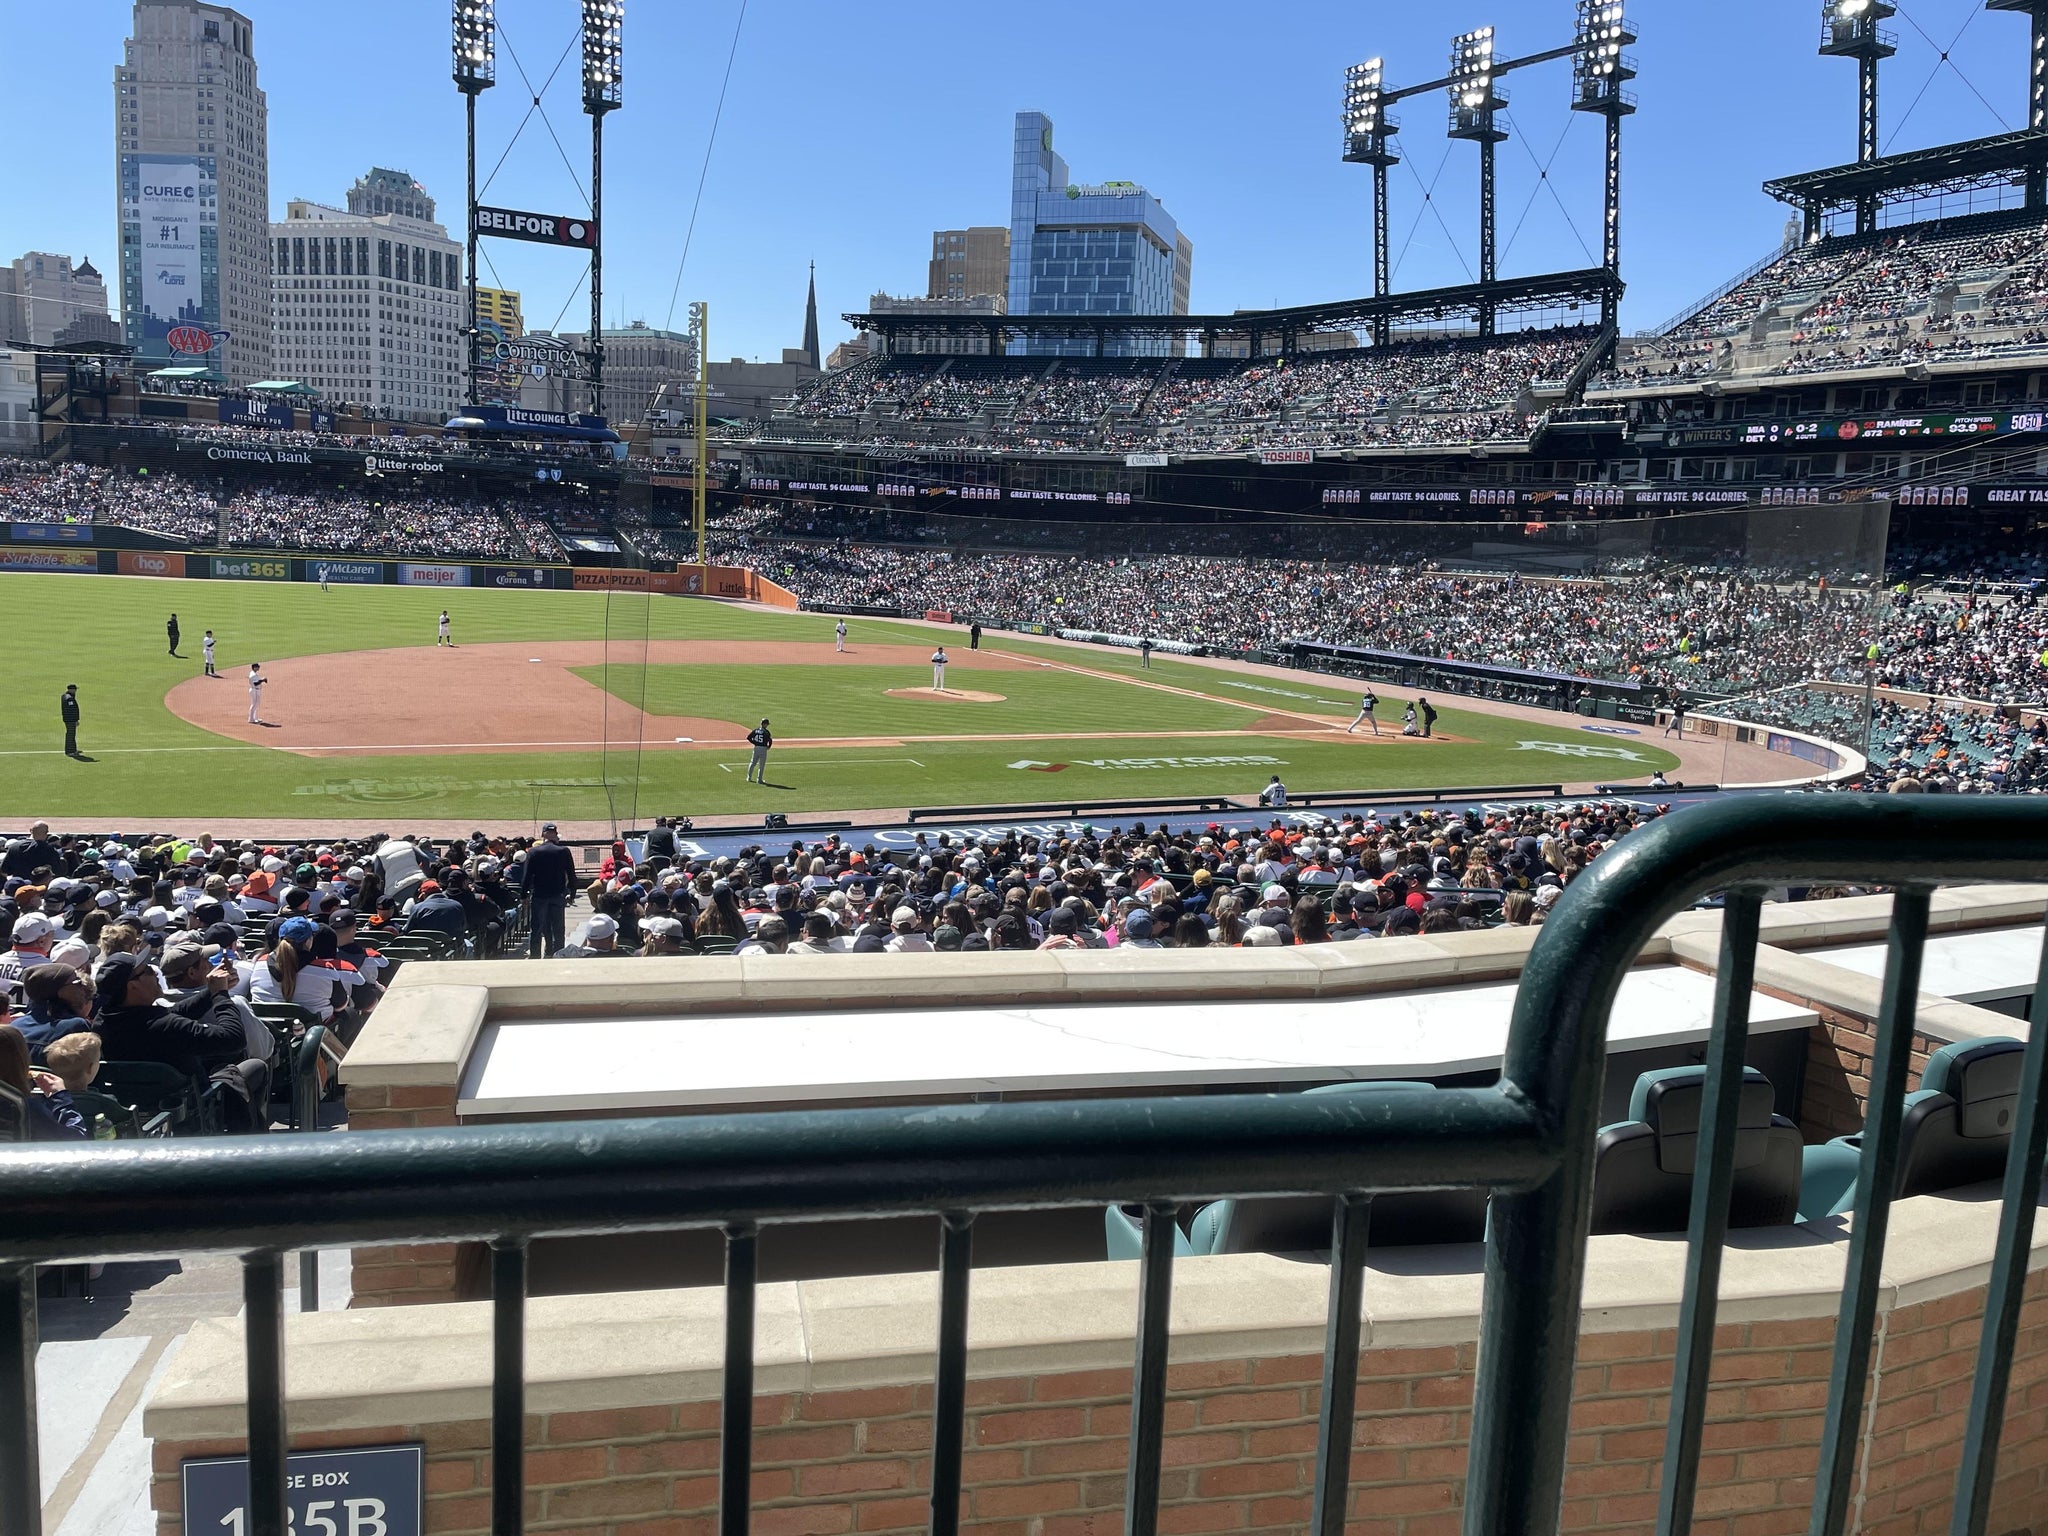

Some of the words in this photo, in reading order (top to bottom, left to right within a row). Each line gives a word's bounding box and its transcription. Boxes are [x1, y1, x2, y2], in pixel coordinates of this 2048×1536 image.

[144, 186, 182, 197] CURE
[1080, 184, 1141, 199] Huntington
[478, 210, 555, 236] BELFOR
[160, 225, 180, 241] #1
[171, 327, 210, 354] AAA
[232, 413, 267, 424] PITCHER'S
[269, 417, 282, 425] PUB
[529, 412, 566, 424] LOUNGE
[1747, 426, 1766, 434] MIA
[1948, 424, 1978, 432] 93.9
[1978, 424, 1996, 432] MPH
[1684, 429, 1732, 443] WINTER'S
[1746, 434, 1766, 442] DET
[277, 451, 312, 464] Bank
[1264, 450, 1311, 463] TOSHIBA
[788, 482, 808, 490] GREAT
[839, 484, 870, 492] CALORIES.
[1054, 492, 1064, 500] 96
[1064, 493, 1098, 501] CALORIES.
[1370, 492, 1391, 500] GREAT
[1415, 492, 1424, 500] 96
[1426, 492, 1461, 501] CALORIES.
[1636, 492, 1662, 502] GREAT
[1692, 492, 1704, 502] 96
[1705, 491, 1748, 502] CALORIES.
[1988, 490, 2026, 502] GREAT
[3, 552, 58, 566] Surfside
[216, 560, 286, 578] bet365
[332, 564, 375, 574] McLaren
[413, 567, 456, 584] meijer
[496, 576, 528, 586] Corona
[574, 574, 609, 586] PIZZA!
[612, 575, 646, 586] PIZZA!
[719, 582, 743, 594] Little
[1022, 624, 1043, 634] bet365
[1070, 755, 1280, 766] VICTORS
[1275, 790, 1285, 798] 77
[312, 1472, 350, 1487] BOX
[220, 1498, 388, 1536] 15B
